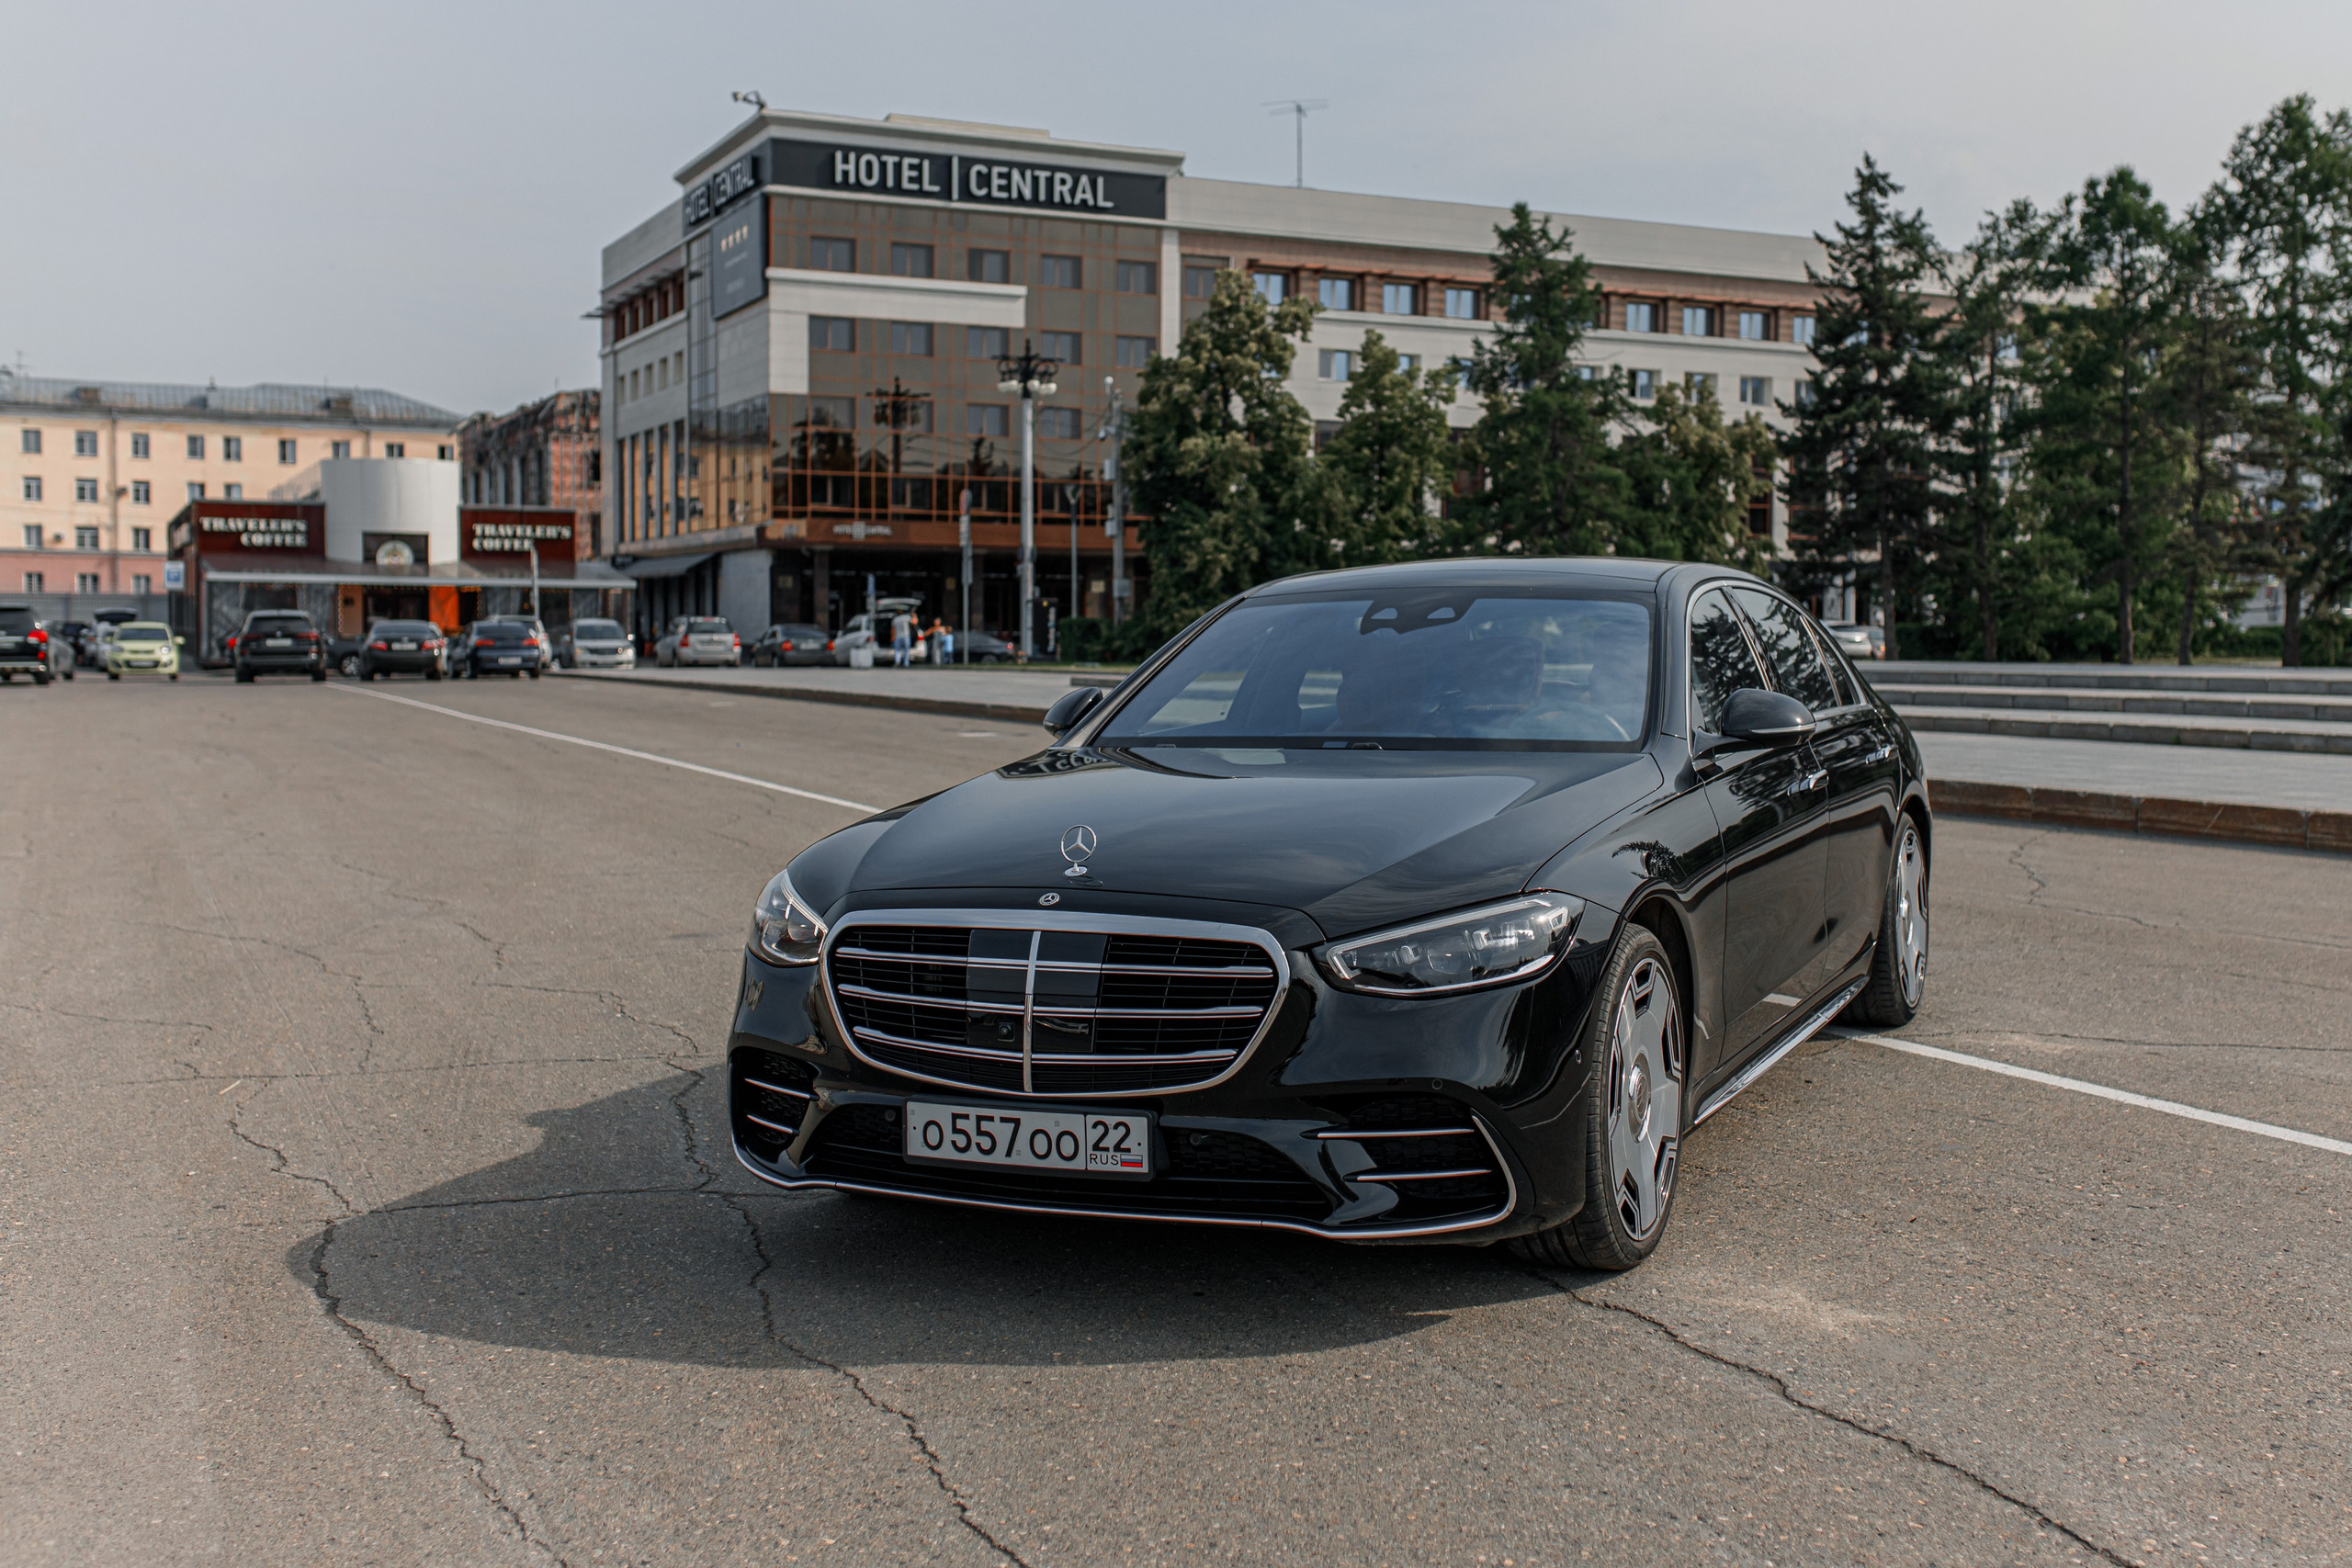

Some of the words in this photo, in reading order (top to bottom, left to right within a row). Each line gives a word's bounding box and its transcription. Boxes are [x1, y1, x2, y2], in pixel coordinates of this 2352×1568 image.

[715, 154, 755, 208] CENTRAL
[834, 150, 941, 193] HOTEL
[968, 164, 1114, 209] CENTRAL
[240, 532, 309, 547] COFFEE
[471, 536, 533, 552] COFFEE
[1091, 1119, 1132, 1154] 22
[1089, 1153, 1119, 1167] RUS
